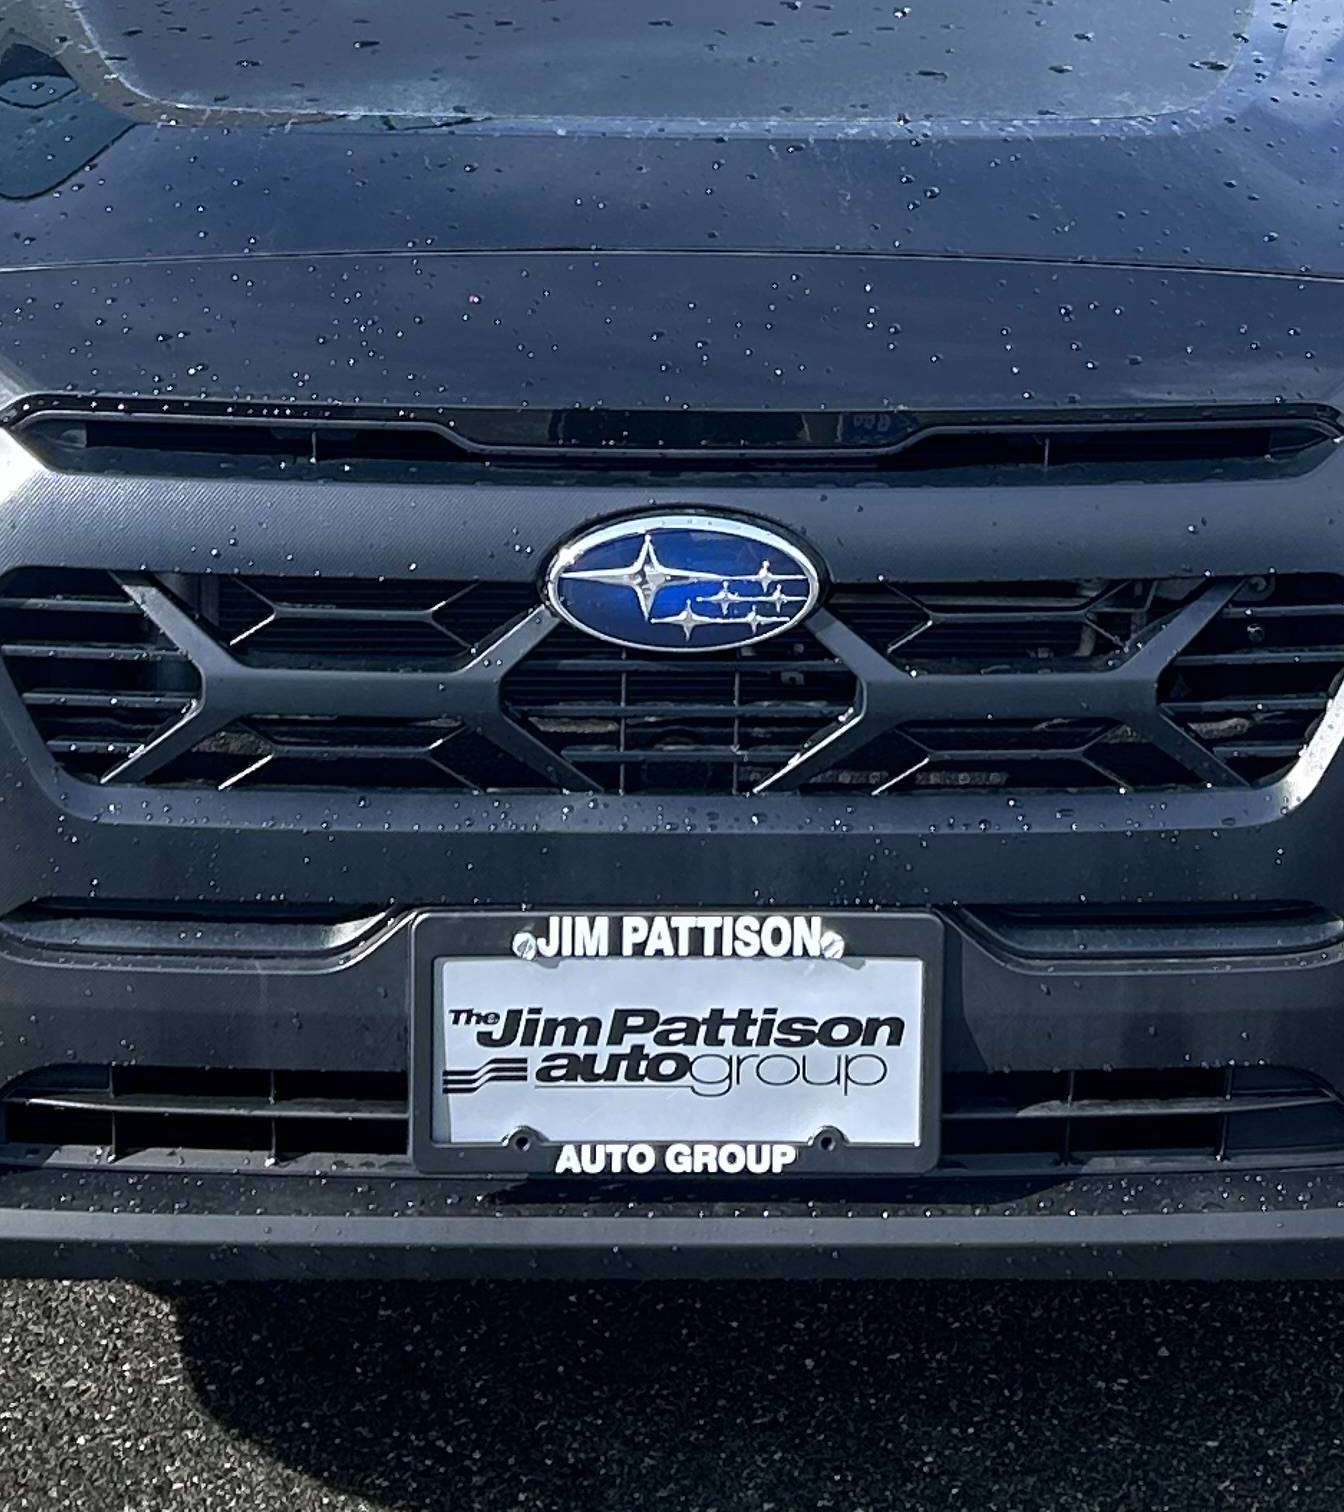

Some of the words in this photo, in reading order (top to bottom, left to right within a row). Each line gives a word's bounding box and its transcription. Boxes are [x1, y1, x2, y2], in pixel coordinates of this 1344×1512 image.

[537, 915, 609, 958] JIM
[621, 915, 823, 958] PATTISON
[448, 1007, 500, 1026] The
[476, 1007, 602, 1048] Jim
[606, 1007, 906, 1048] Pattison
[556, 1143, 655, 1174] AUTO
[664, 1143, 797, 1174] GROUP
